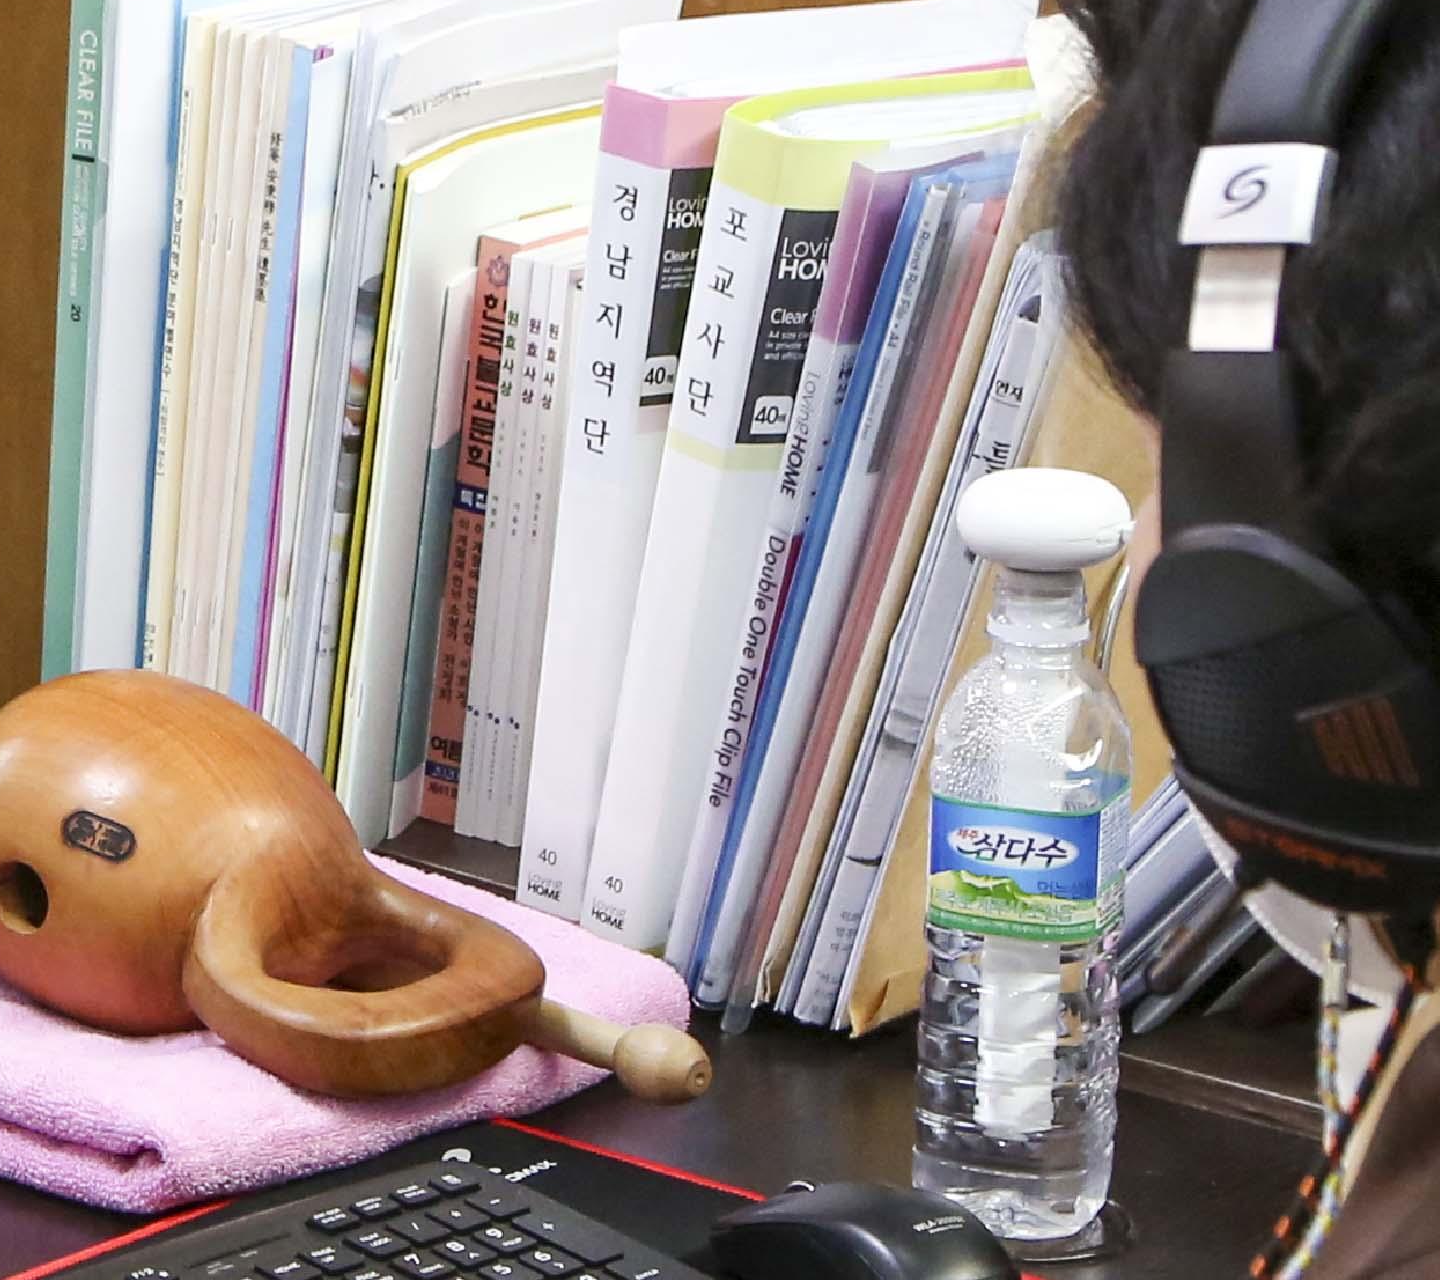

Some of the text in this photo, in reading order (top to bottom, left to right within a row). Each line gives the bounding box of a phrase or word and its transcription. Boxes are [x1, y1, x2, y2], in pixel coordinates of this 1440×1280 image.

[75, 29, 99, 101] CLEAR
[74, 108, 97, 153] FILE
[70, 304, 82, 322] 20
[583, 183, 639, 455] 경남지역단
[687, 205, 749, 417] 포교사단
[708, 535, 788, 809] Double One Touch Clip File
[538, 847, 558, 866] 40
[973, 832, 1068, 868] 삼다수
[527, 882, 561, 903] HOME
[605, 874, 624, 894] 40
[591, 907, 625, 931] HOME
